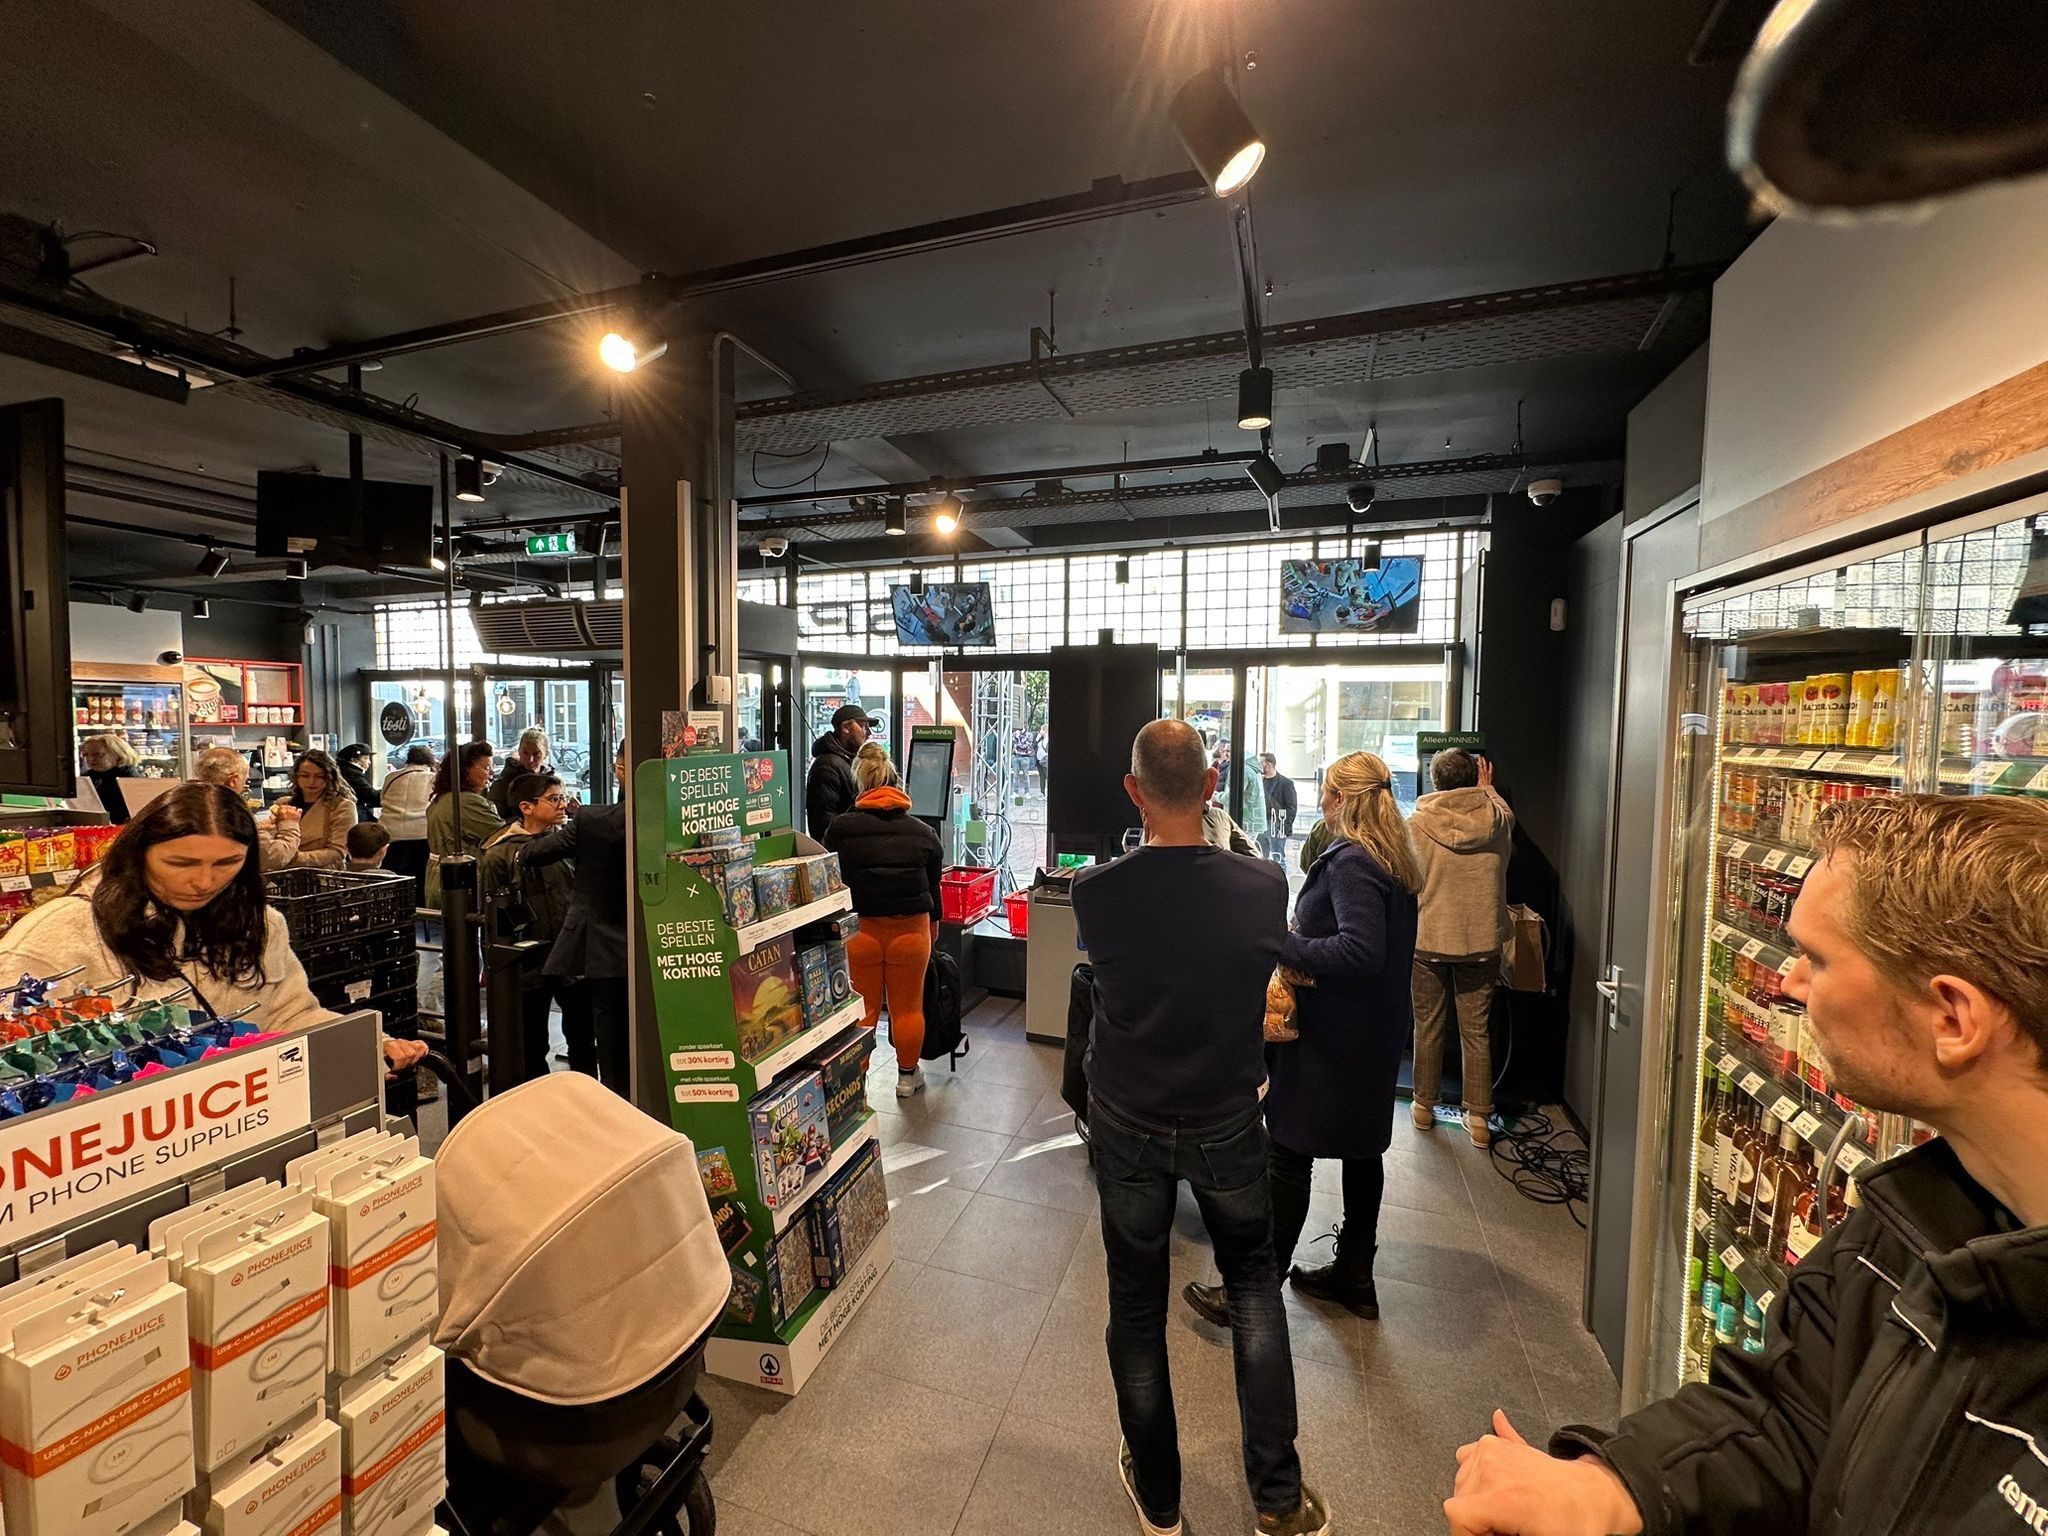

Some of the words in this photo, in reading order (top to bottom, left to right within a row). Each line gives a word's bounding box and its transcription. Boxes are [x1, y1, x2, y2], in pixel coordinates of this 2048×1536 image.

[382, 715, 408, 731] tosti
[1422, 736, 1447, 744] Alleen
[1448, 736, 1480, 744] PINNEN
[680, 769, 697, 785] DE
[697, 765, 732, 782] BESTE
[680, 781, 729, 801] SPELLEN
[681, 803, 706, 820] MET
[707, 797, 740, 815] HOGE
[682, 813, 734, 836] KORTING
[657, 922, 675, 936] DE
[676, 919, 716, 934] BESTE
[660, 933, 715, 949] SPELLEN
[656, 954, 683, 968] MET
[685, 951, 724, 966] HOGE
[748, 943, 782, 971] CATAN
[662, 965, 721, 980] KORTING
[676, 1057, 687, 1065] tot
[687, 1056, 703, 1065] 30%
[703, 1055, 730, 1065] korting
[692, 1089, 707, 1097] 50%
[708, 1087, 734, 1098] korting
[825, 1075, 861, 1117] SECONDS
[0, 1068, 269, 1192] NEJUICE
[29, 1153, 145, 1214] PHONE
[155, 1108, 269, 1165] SUPPLIES
[372, 1175, 423, 1208] PHONEJUICE
[247, 1236, 313, 1275] PHONEJUICE
[818, 1329, 836, 1352] MET
[834, 1304, 853, 1331] HOGE
[851, 1267, 878, 1308] KORTING
[819, 1316, 829, 1336] DE
[829, 1290, 850, 1322] BESTE
[849, 1260, 875, 1298] SPELLEN
[76, 1313, 165, 1366] PHONEJUICE
[381, 1367, 434, 1412] PHONEJUICE
[43, 1394, 152, 1461] USB-C-NAAR-USB-C
[153, 1376, 183, 1398] KABEL
[261, 1447, 328, 1501] PHONEJUICE
